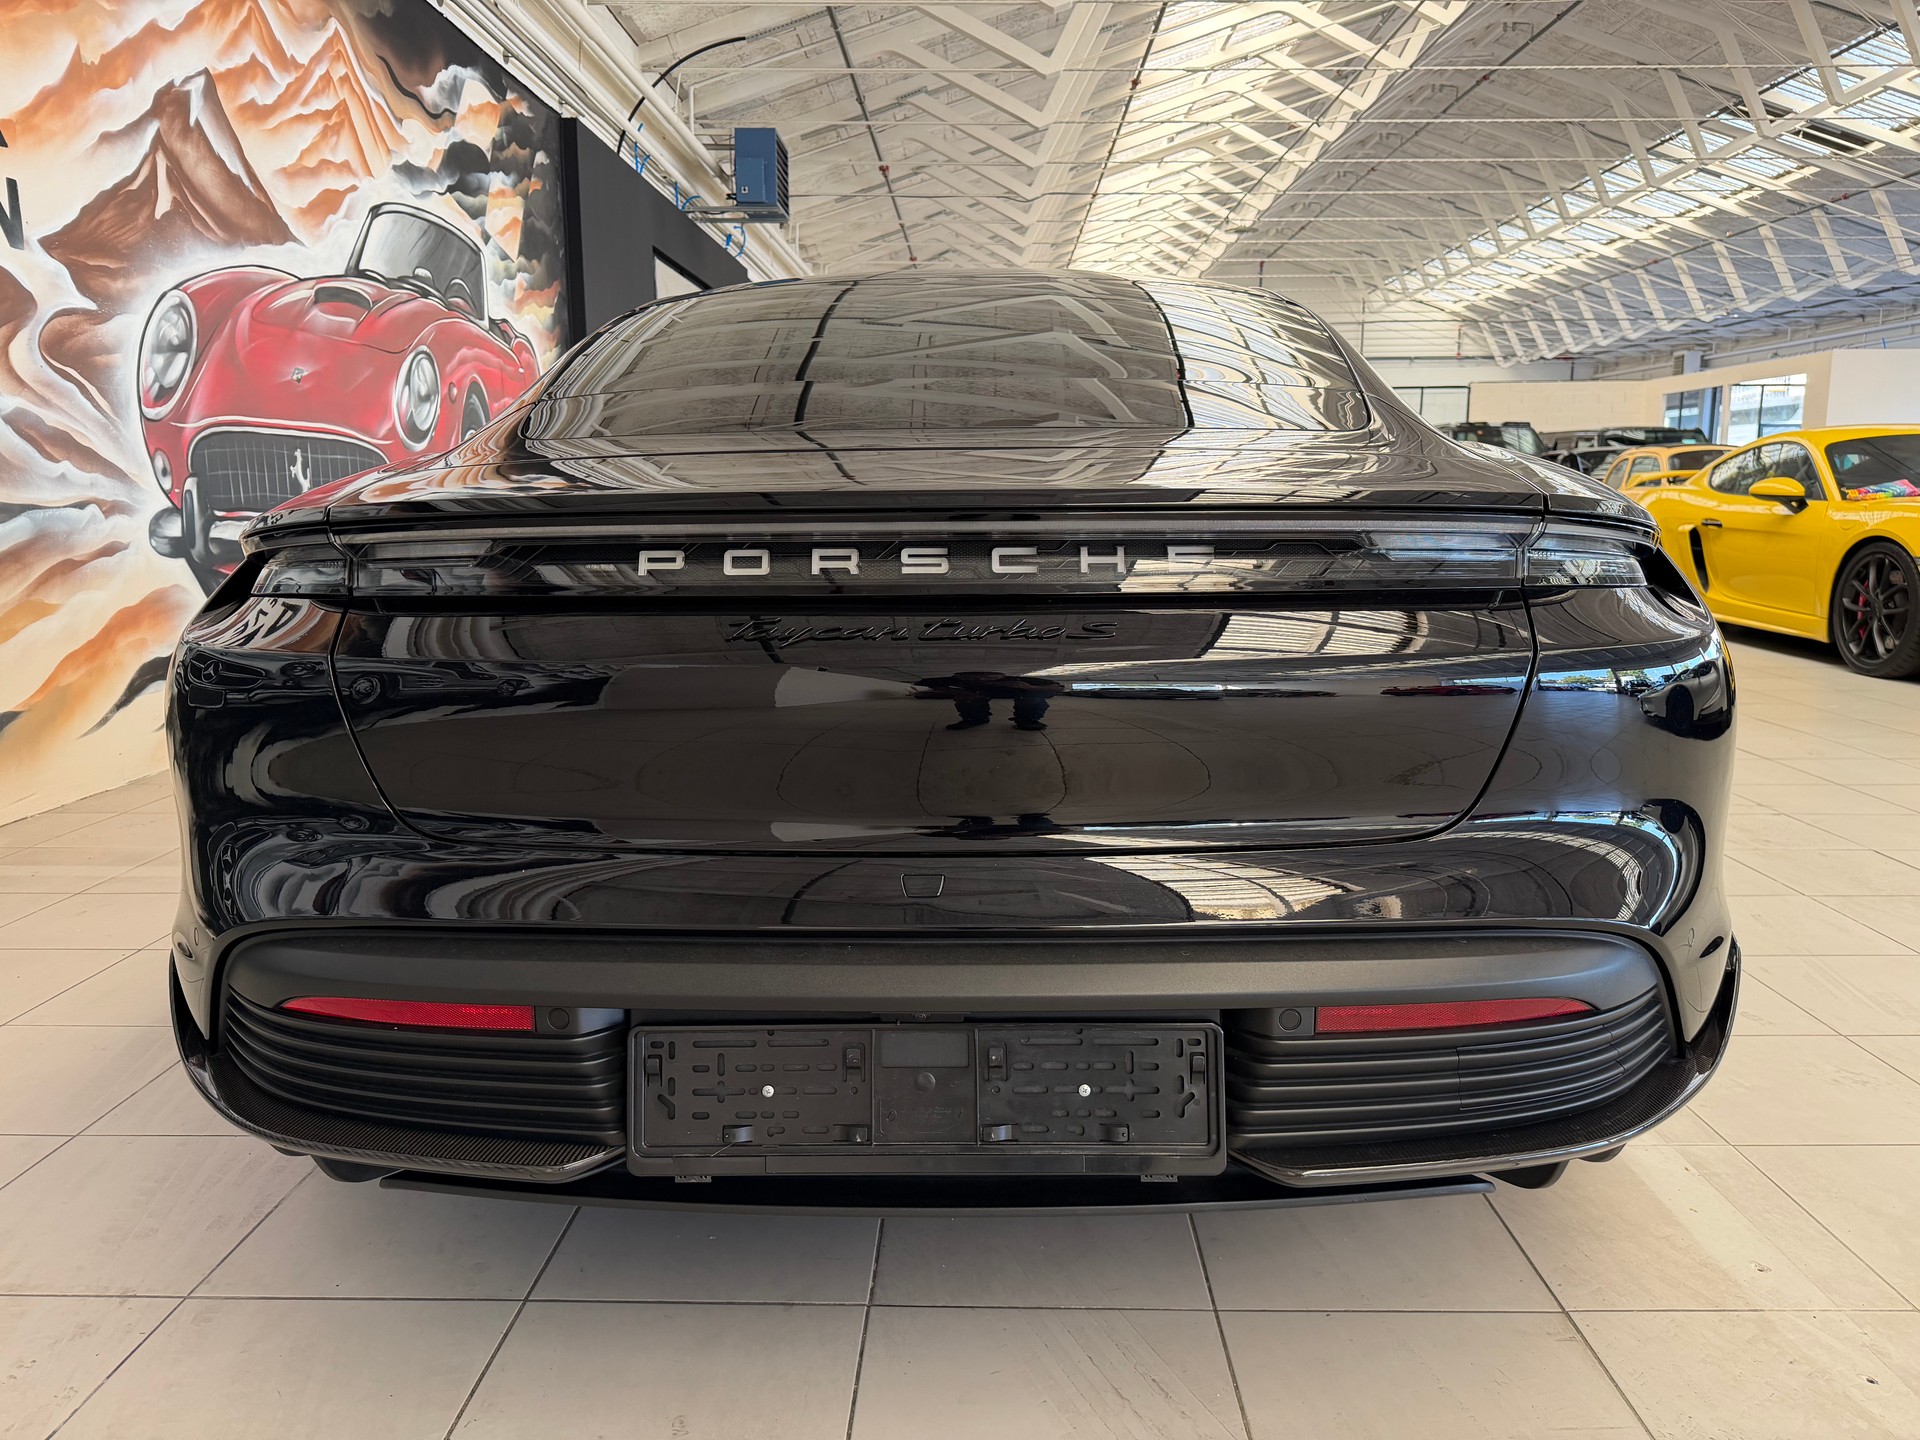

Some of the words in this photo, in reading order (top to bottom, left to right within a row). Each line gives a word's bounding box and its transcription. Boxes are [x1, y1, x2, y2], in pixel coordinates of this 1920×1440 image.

[637, 545, 1216, 576] PORSCHE
[725, 617, 910, 649] Taycan
[1066, 622, 1118, 640] S
